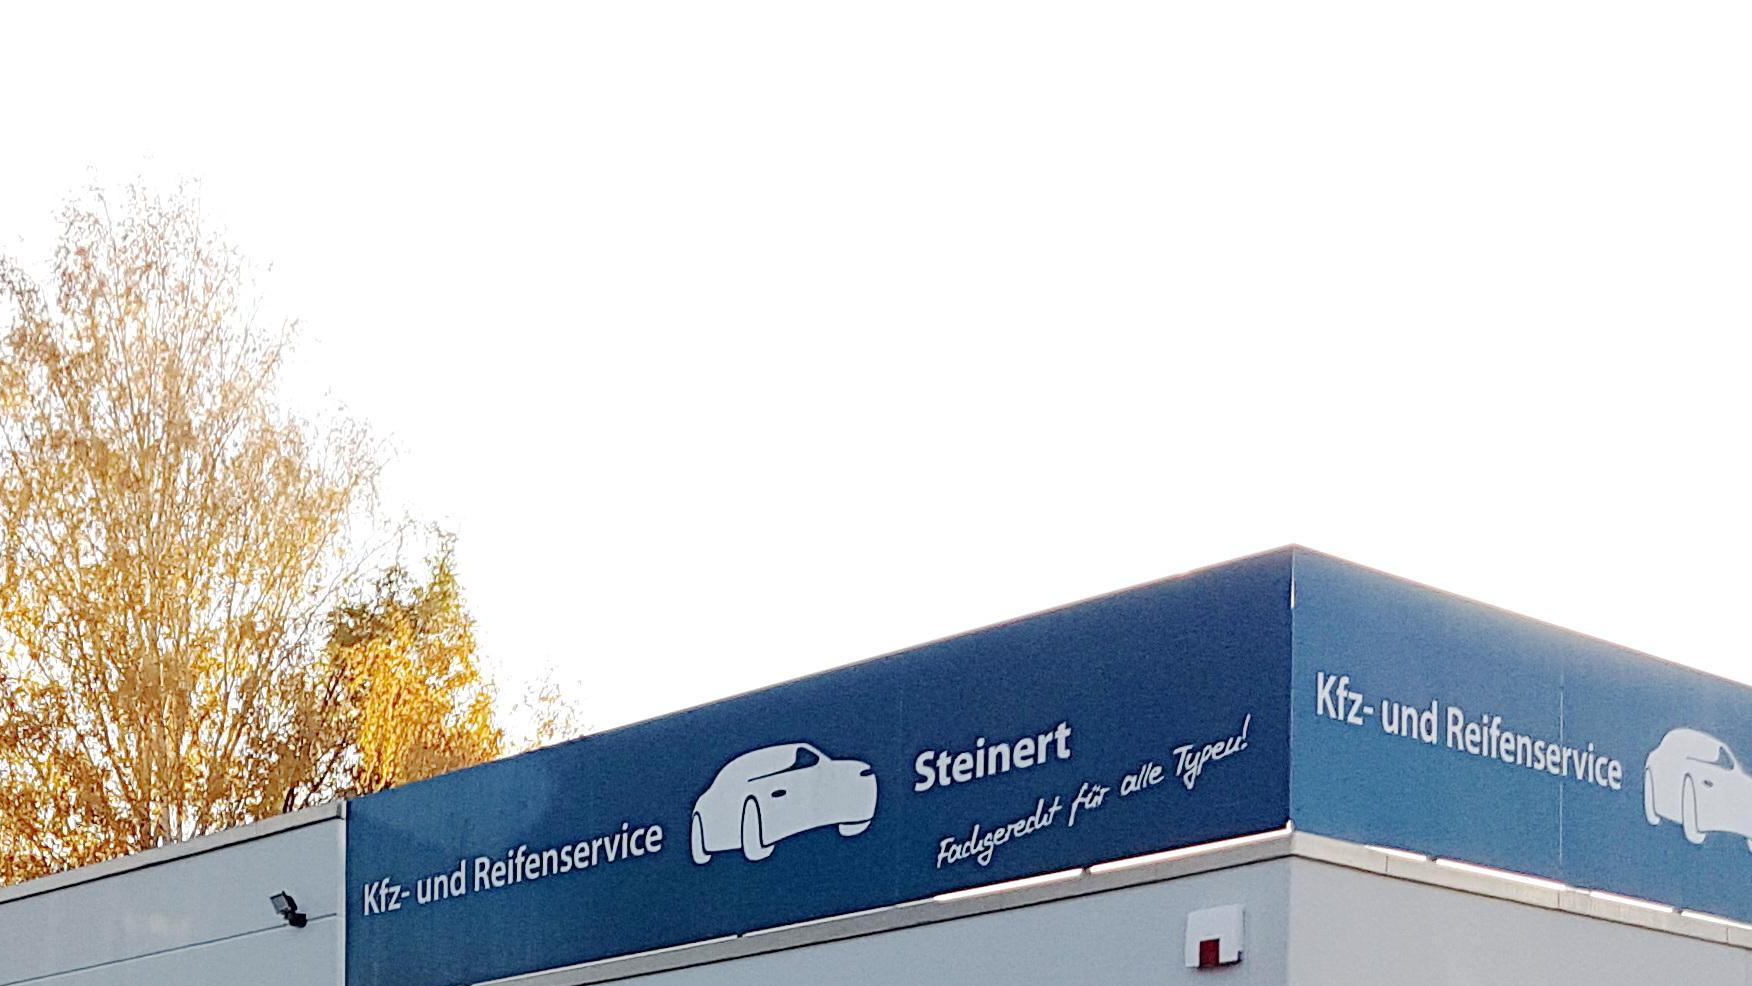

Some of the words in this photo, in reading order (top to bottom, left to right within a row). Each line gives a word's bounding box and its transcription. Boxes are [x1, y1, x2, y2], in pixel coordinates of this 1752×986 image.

[914, 721, 1072, 792] Steinert
[1315, 671, 1374, 726] Kfz-
[1381, 700, 1438, 744] und
[1447, 706, 1623, 790] Reifenservice
[936, 796, 1062, 868] Fachgerecht
[1068, 783, 1110, 827] für
[1121, 763, 1165, 797] alle
[1173, 713, 1251, 790] Typen!
[363, 876, 410, 916] Kfz-
[417, 859, 466, 904] und
[474, 822, 664, 892] Reifenservice
